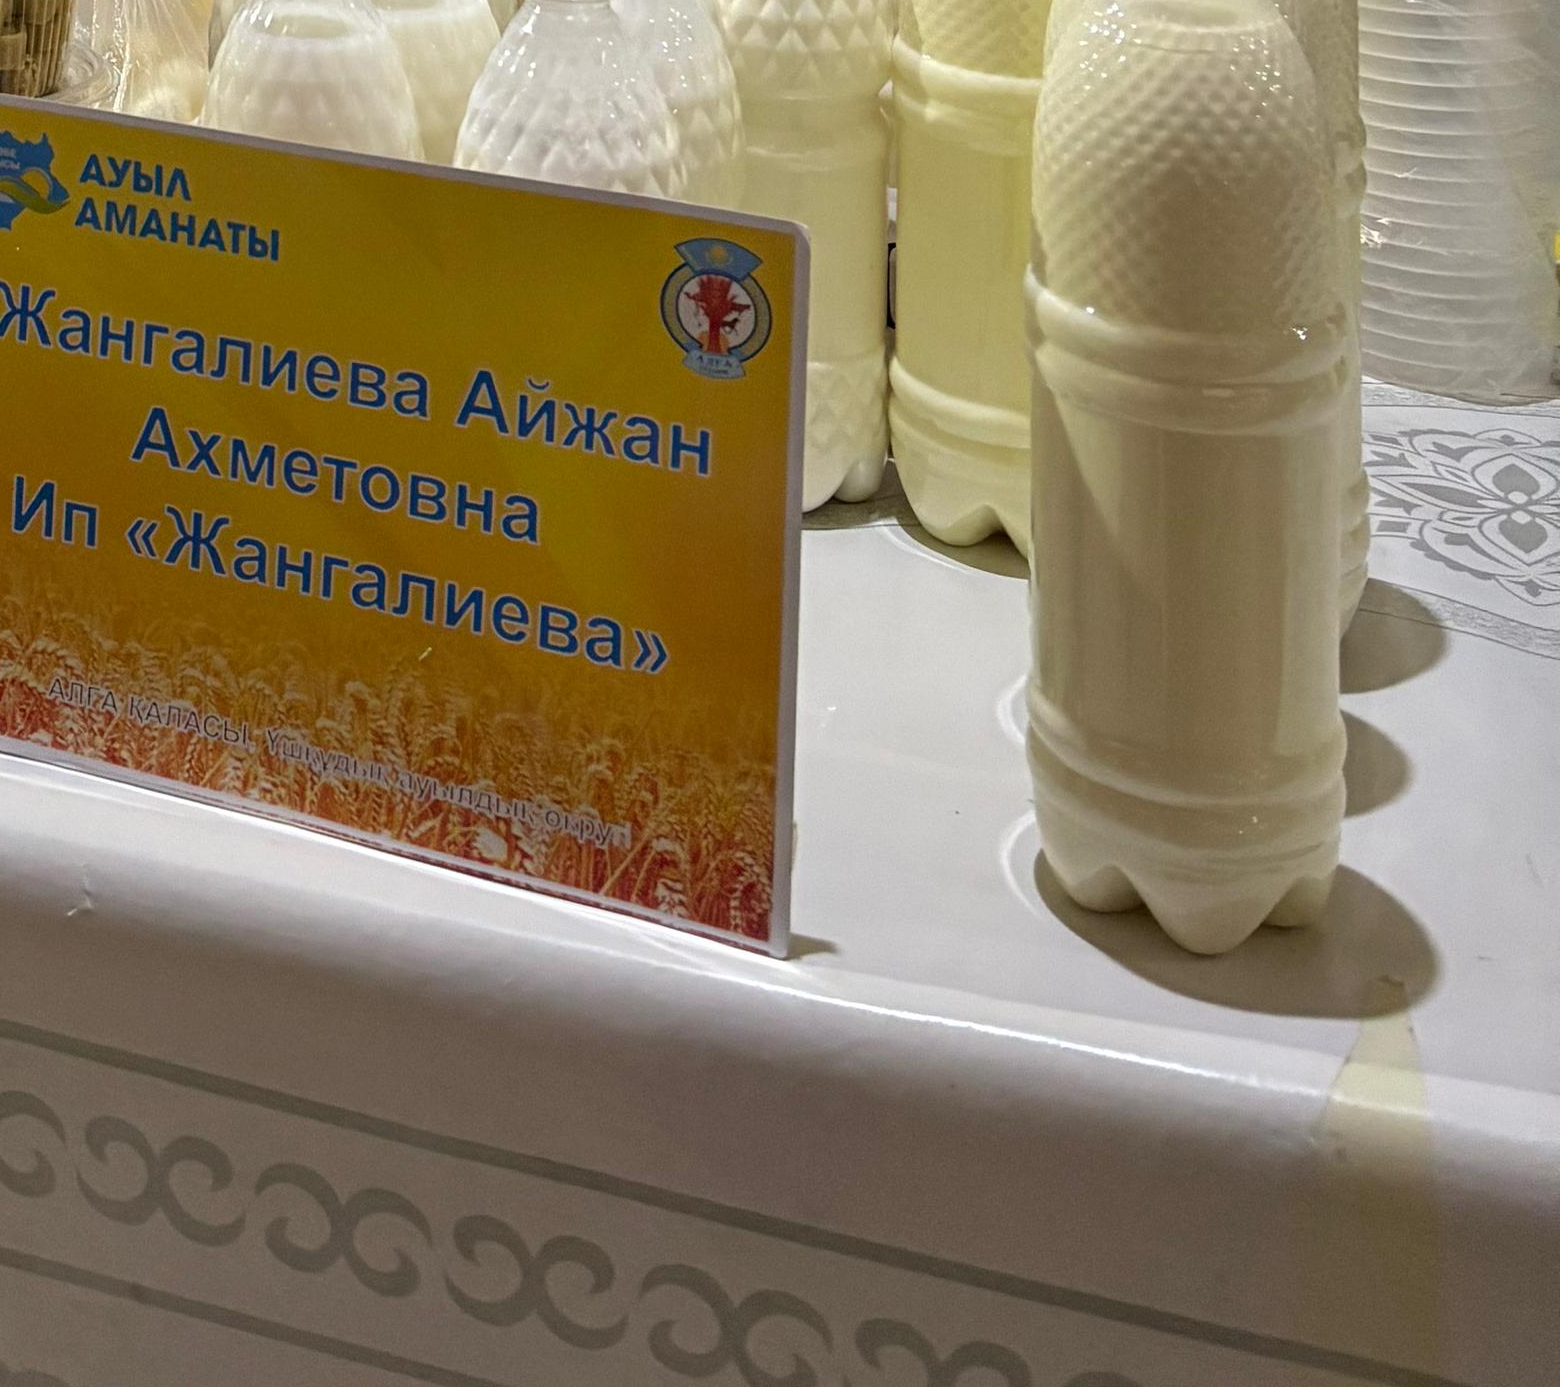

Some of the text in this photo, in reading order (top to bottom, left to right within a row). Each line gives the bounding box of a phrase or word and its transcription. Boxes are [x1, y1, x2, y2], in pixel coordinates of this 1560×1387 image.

[74, 197, 280, 261] АМАНАТЫ
[79, 154, 191, 201] АУЫЛ
[130, 406, 541, 543] Ахметовна
[456, 369, 712, 476] Айжан
[10, 476, 670, 675] Ип «Жангалиева»
